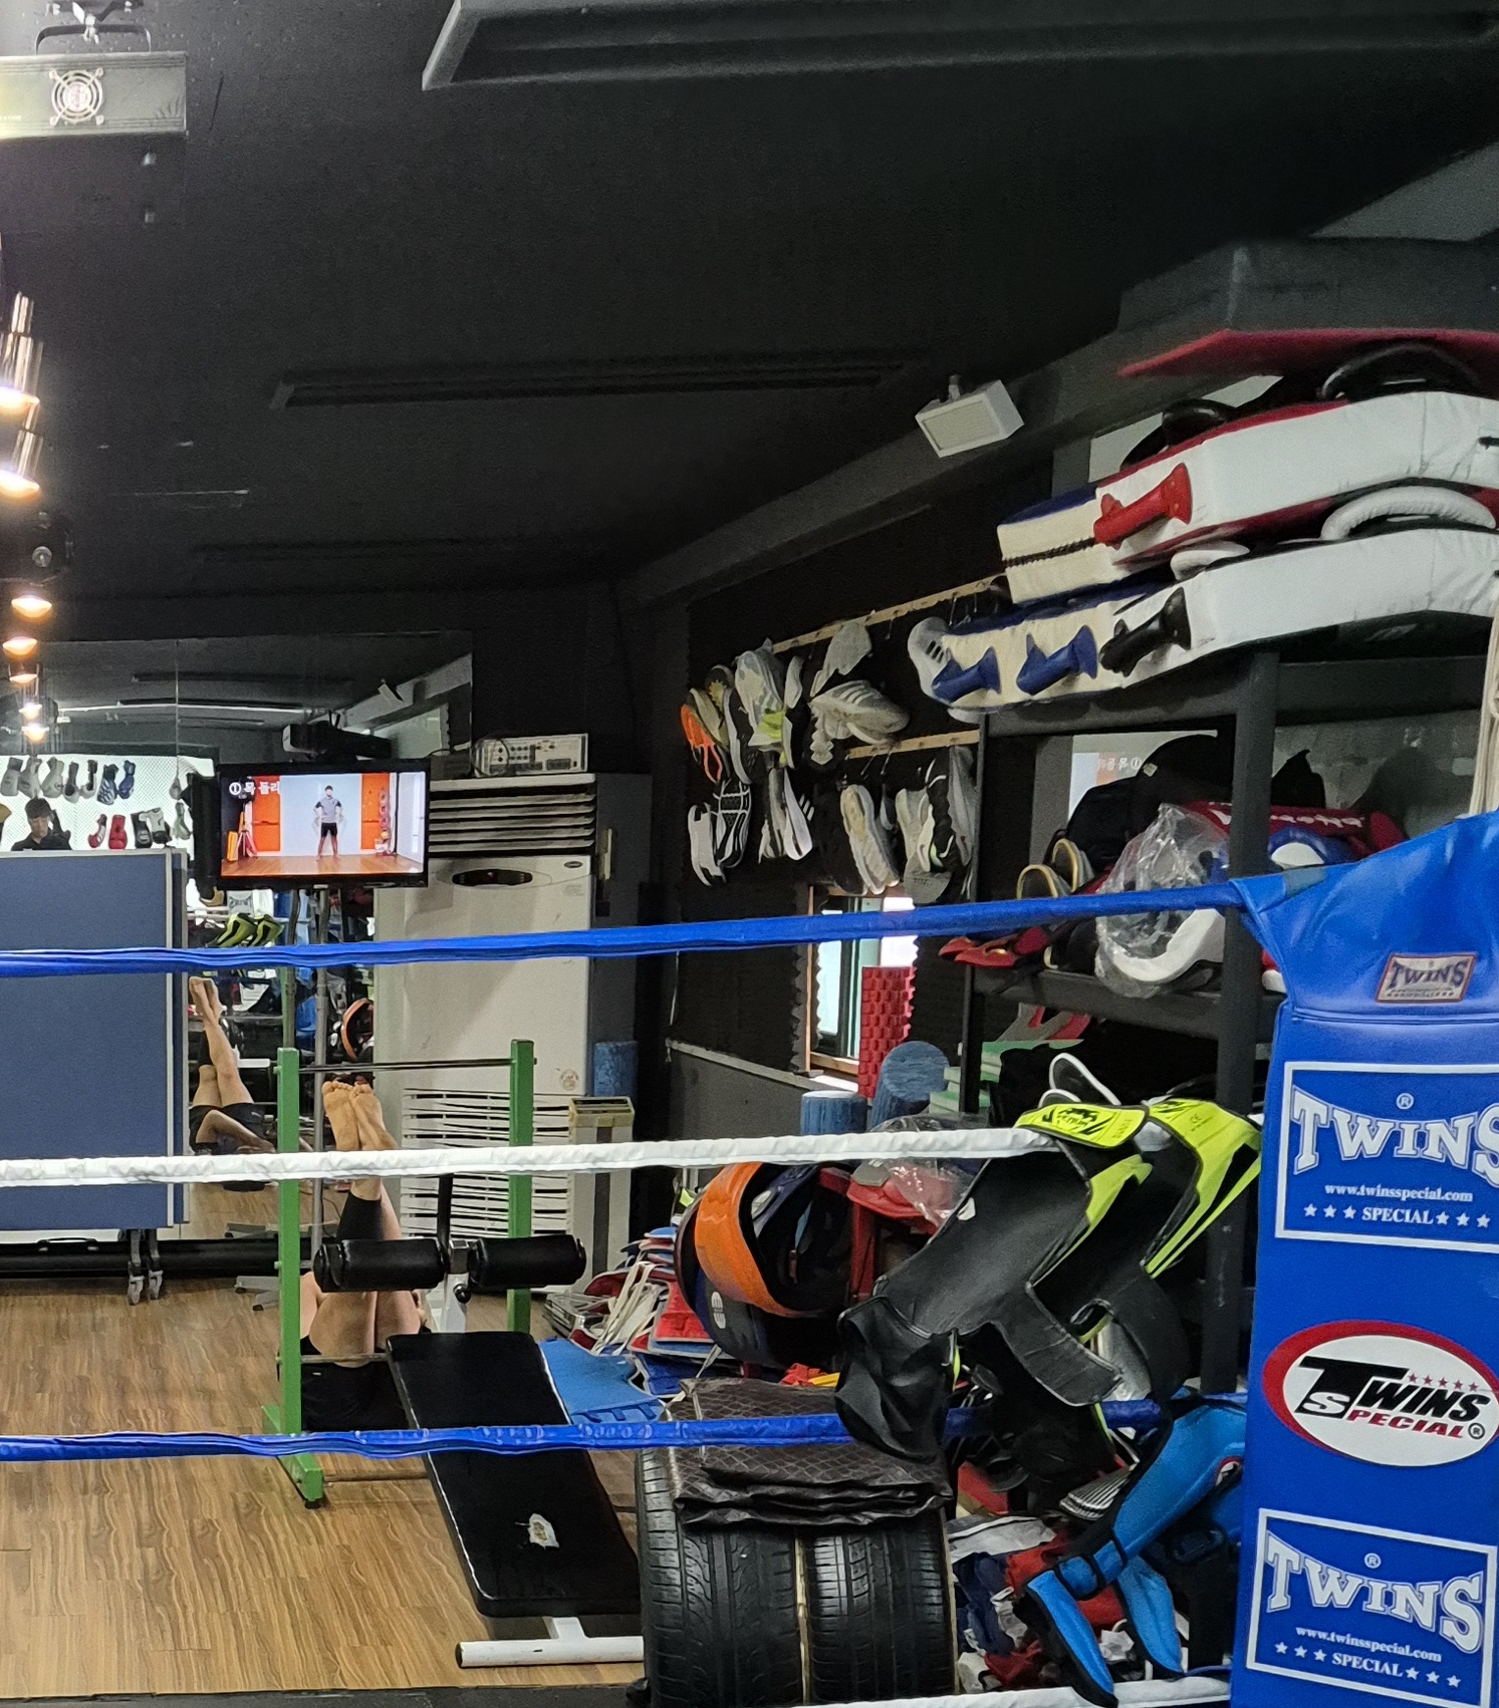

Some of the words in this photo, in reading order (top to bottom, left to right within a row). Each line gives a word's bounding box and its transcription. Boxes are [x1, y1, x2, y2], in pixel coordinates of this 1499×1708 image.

[1387, 959, 1471, 989] TWINS
[1292, 1085, 1499, 1188] TWINS
[1324, 1184, 1474, 1203] www.twinsspecial.com
[1362, 1207, 1434, 1225] SPECIAL
[1294, 1355, 1491, 1422] TWINS
[1265, 1530, 1484, 1654] TWINS
[1295, 1626, 1442, 1662] www.twinsspecial.com
[1331, 1652, 1404, 1678] SPECIAL
